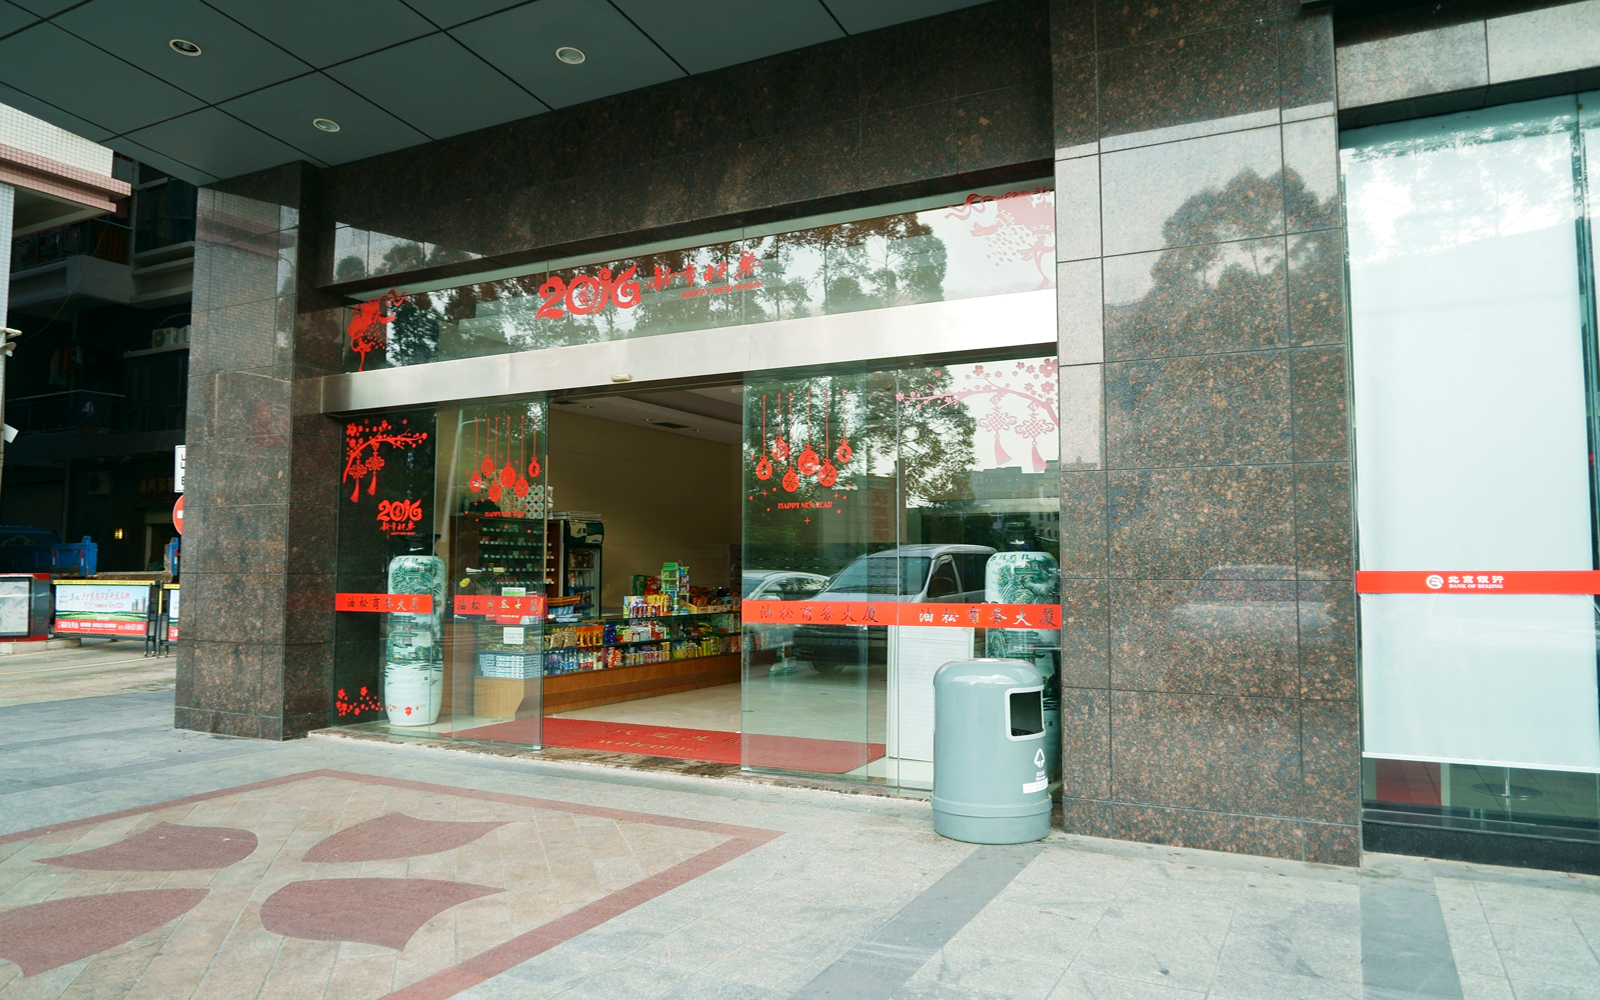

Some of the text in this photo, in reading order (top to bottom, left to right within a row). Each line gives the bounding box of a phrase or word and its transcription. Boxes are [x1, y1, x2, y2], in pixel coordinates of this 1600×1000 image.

[535, 263, 642, 320] 2016
[680, 280, 764, 299] HAPPY NEW YEAR!
[376, 499, 423, 522] 2016
[777, 502, 800, 510] HAPPY
[1448, 575, 1504, 583] 北京银行
[346, 596, 420, 612] 油松商务大厦
[760, 604, 880, 623] 油松商务大厦
[918, 605, 1059, 627] 油松商务大厦
